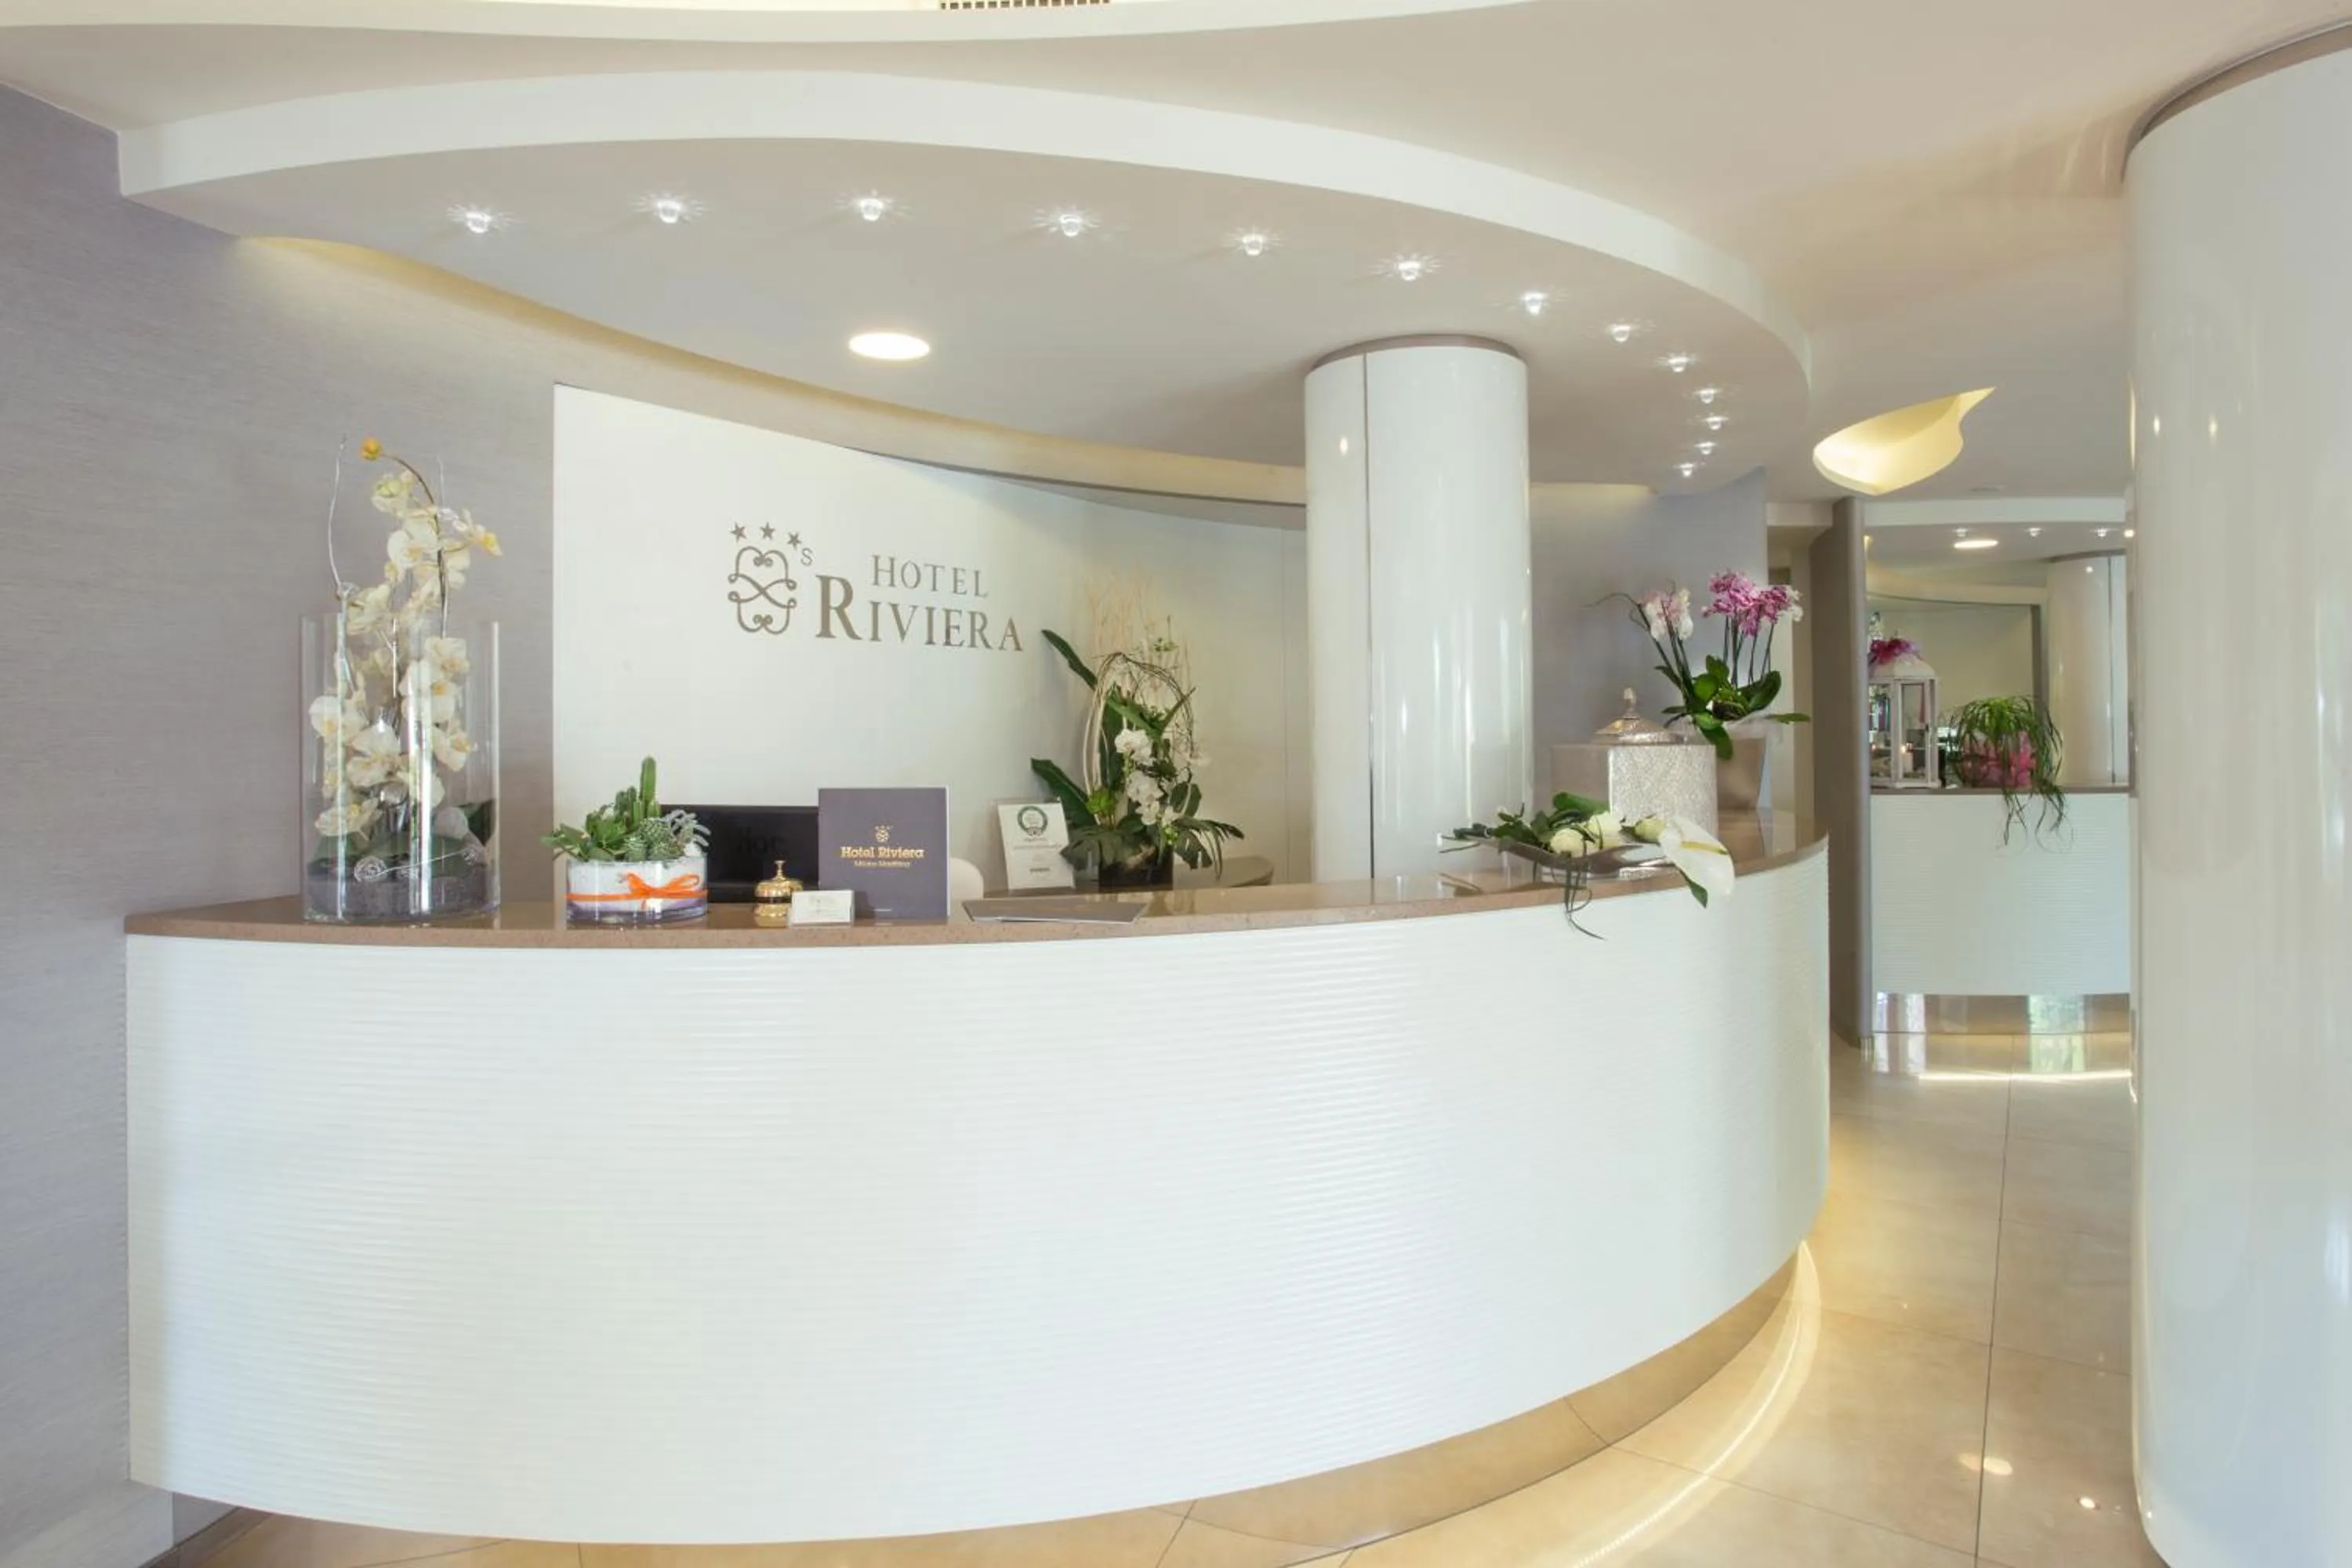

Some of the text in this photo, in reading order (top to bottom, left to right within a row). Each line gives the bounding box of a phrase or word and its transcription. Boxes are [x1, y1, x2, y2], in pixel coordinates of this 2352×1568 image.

[800, 547, 813, 566] S
[873, 554, 988, 598] HOTEL
[815, 575, 1023, 652] RIVIERA
[840, 846, 924, 858] Hotel Riviera
